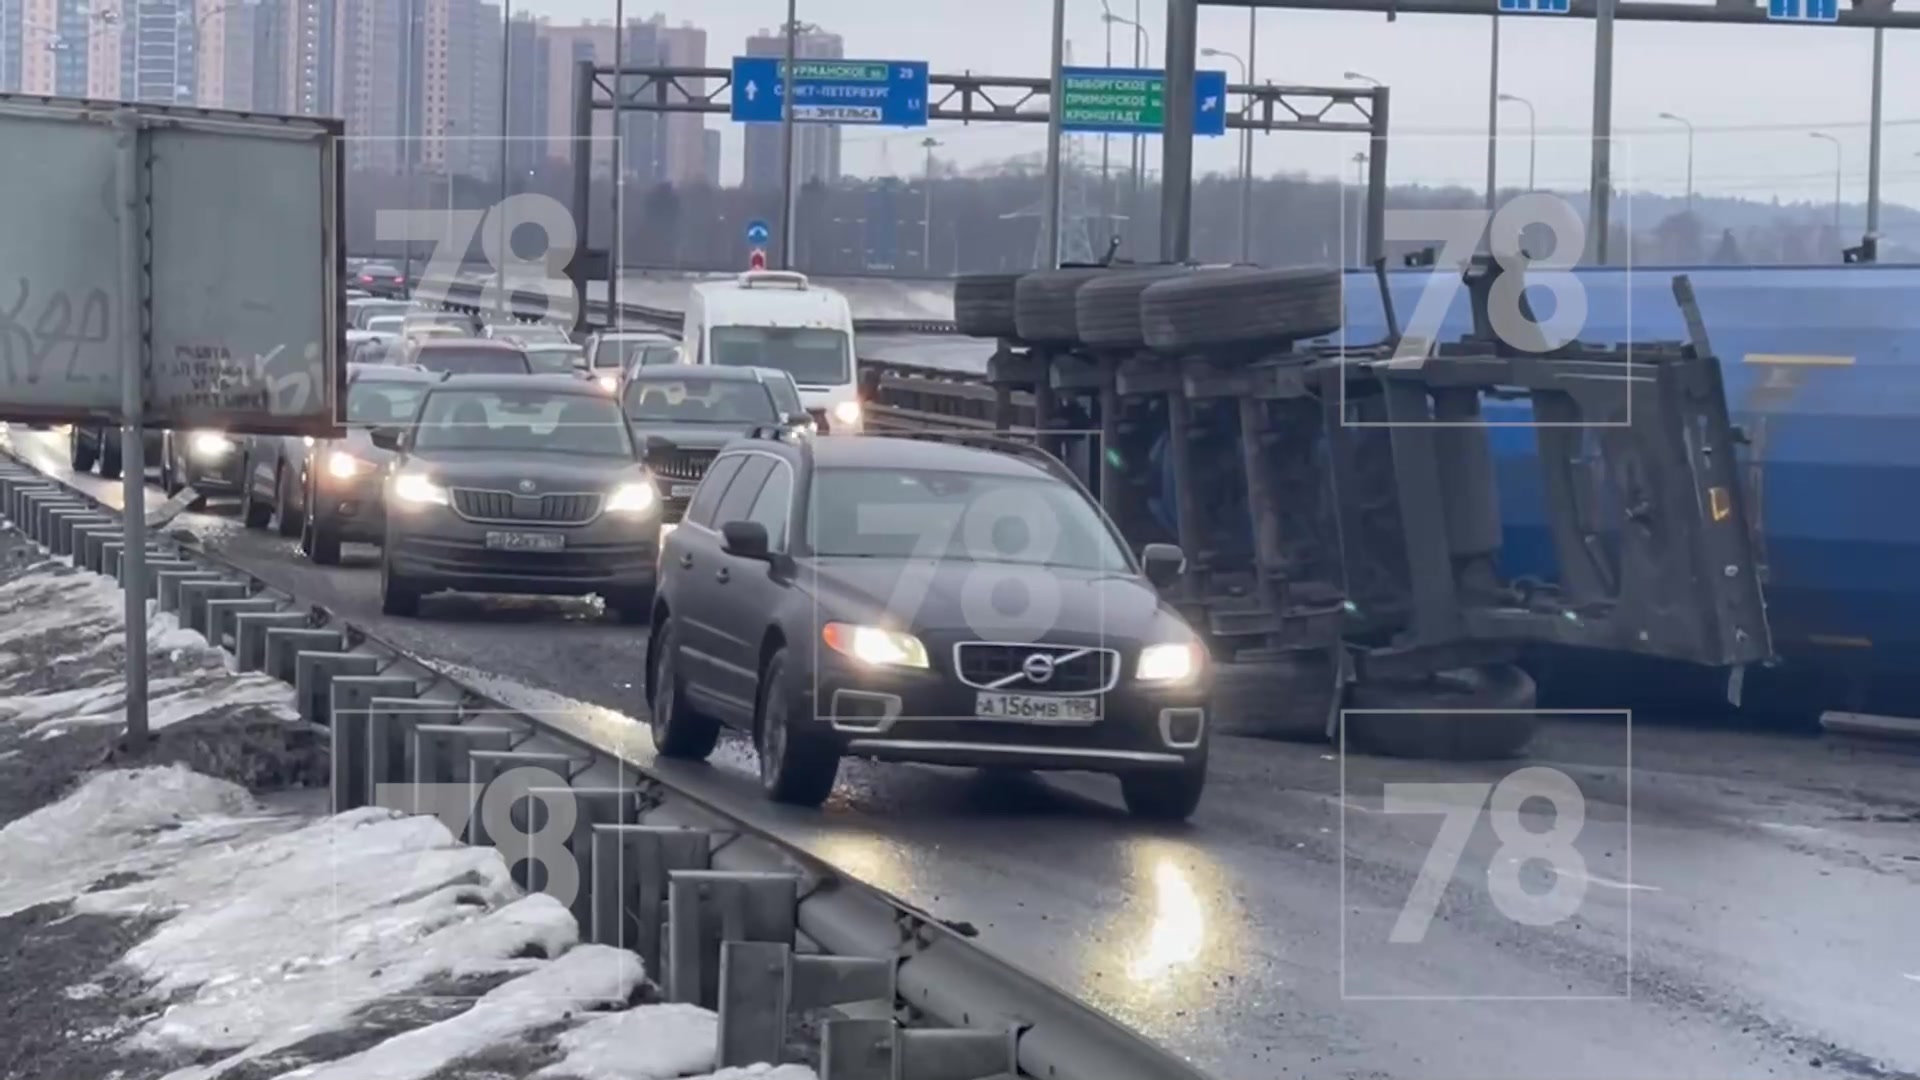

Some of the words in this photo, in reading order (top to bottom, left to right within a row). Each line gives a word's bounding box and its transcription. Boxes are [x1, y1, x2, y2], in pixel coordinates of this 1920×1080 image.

[773, 85, 890, 98] СНКТ-ПЕТЕРБУРГ
[1066, 79, 1146, 91] ВЫБОРГСКОЕ
[1065, 94, 1146, 107] ПРИМОРСКОЕ
[816, 108, 879, 119] ЭНГЕЛЬСА
[1066, 109, 1141, 122] КРОНШТАДТ
